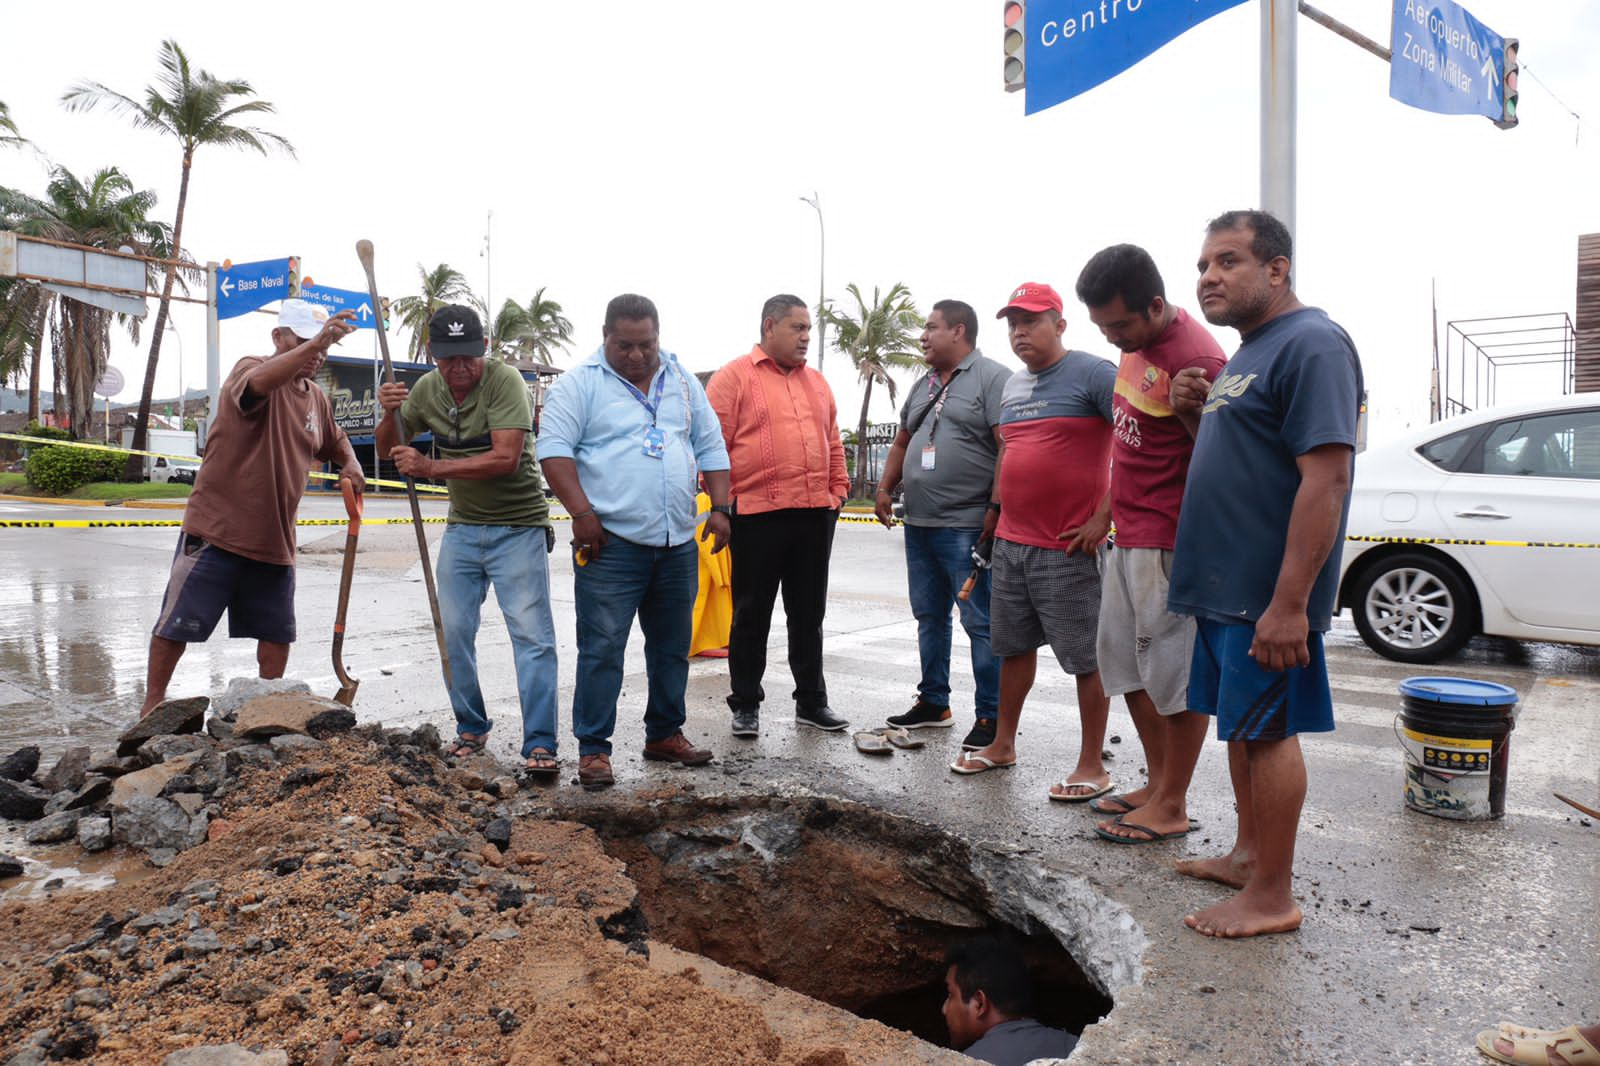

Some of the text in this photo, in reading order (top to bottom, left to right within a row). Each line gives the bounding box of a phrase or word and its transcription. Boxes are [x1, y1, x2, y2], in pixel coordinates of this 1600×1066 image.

[1404, 0, 1479, 59] Aeropuerto
[1402, 32, 1472, 94] Zona Militar
[238, 275, 283, 291] Base Naval
[322, 292, 332, 302] de
[333, 295, 344, 304] las
[336, 419, 360, 428] CAPULCO
